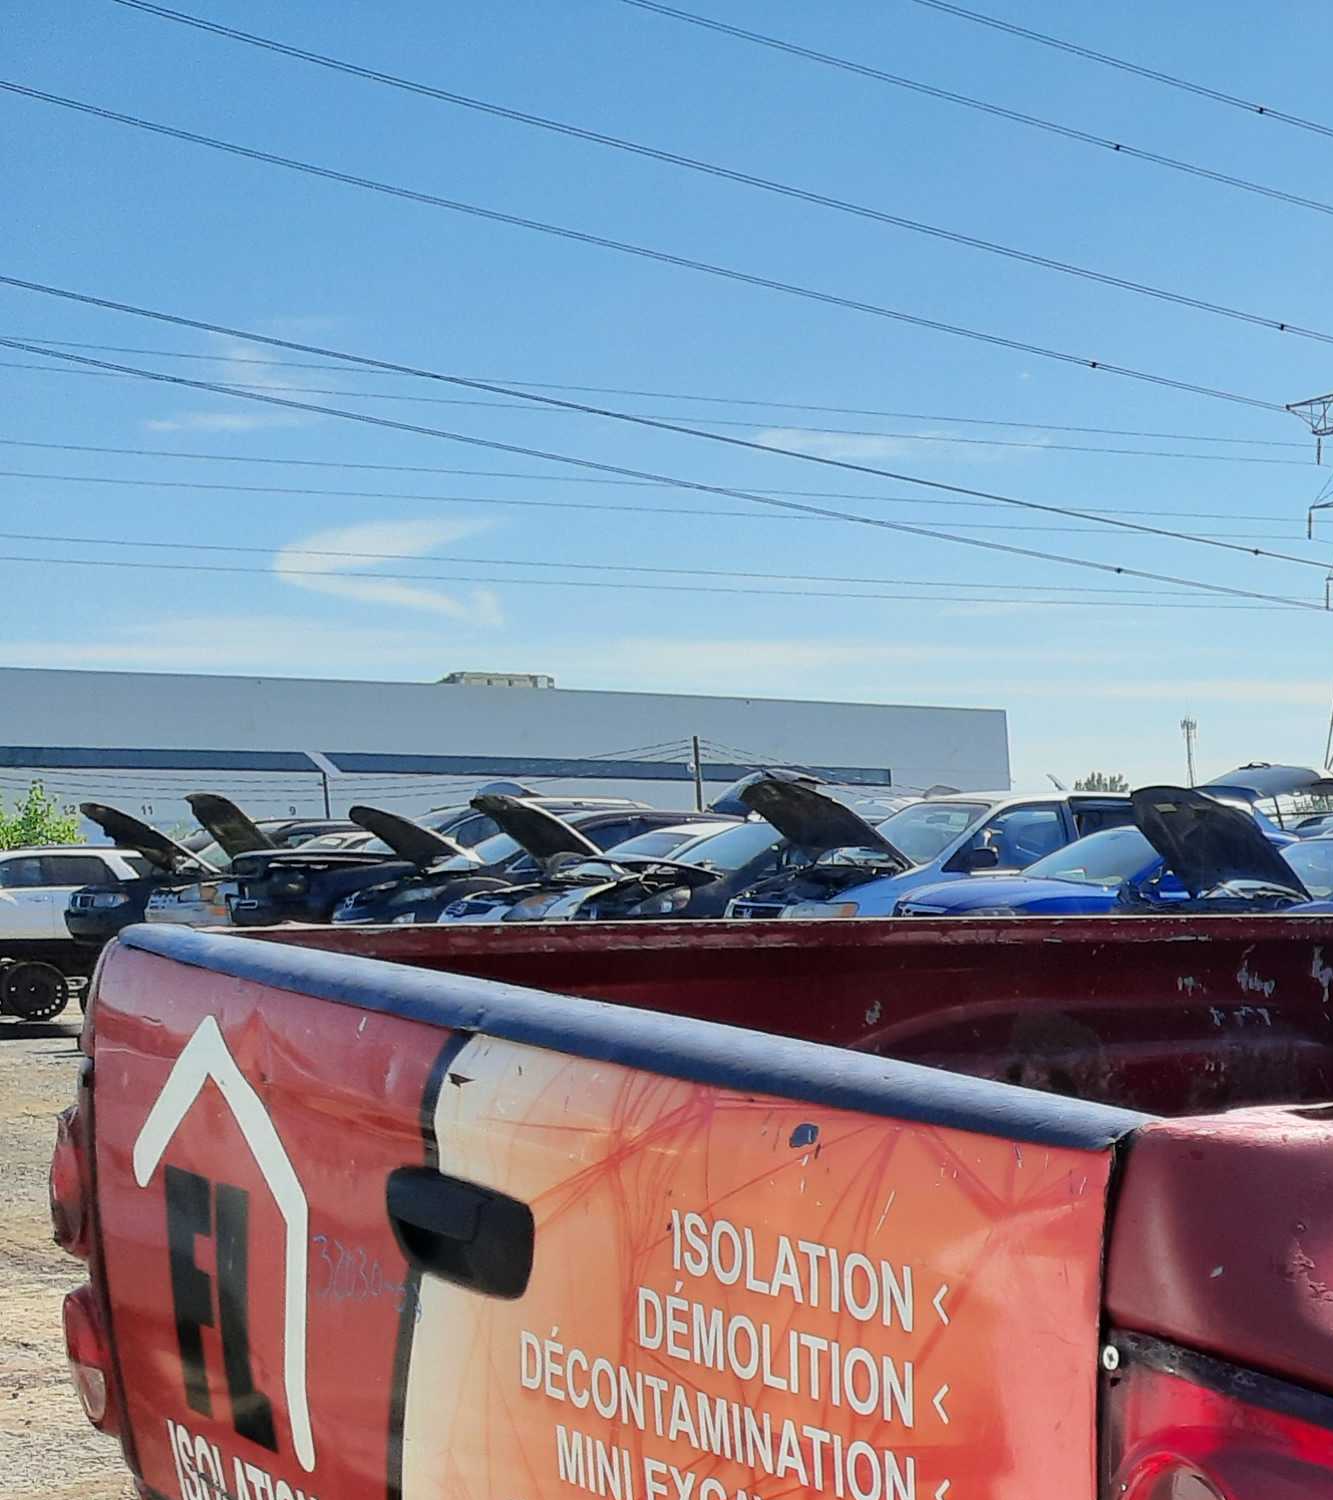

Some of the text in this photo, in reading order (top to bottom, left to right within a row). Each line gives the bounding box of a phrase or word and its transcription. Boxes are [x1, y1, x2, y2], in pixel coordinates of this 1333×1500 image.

[141, 805, 153, 815] 11
[165, 1163, 279, 1454] FL
[671, 1208, 914, 1333] ISOLATION
[637, 1282, 914, 1428] DÉMOLITION
